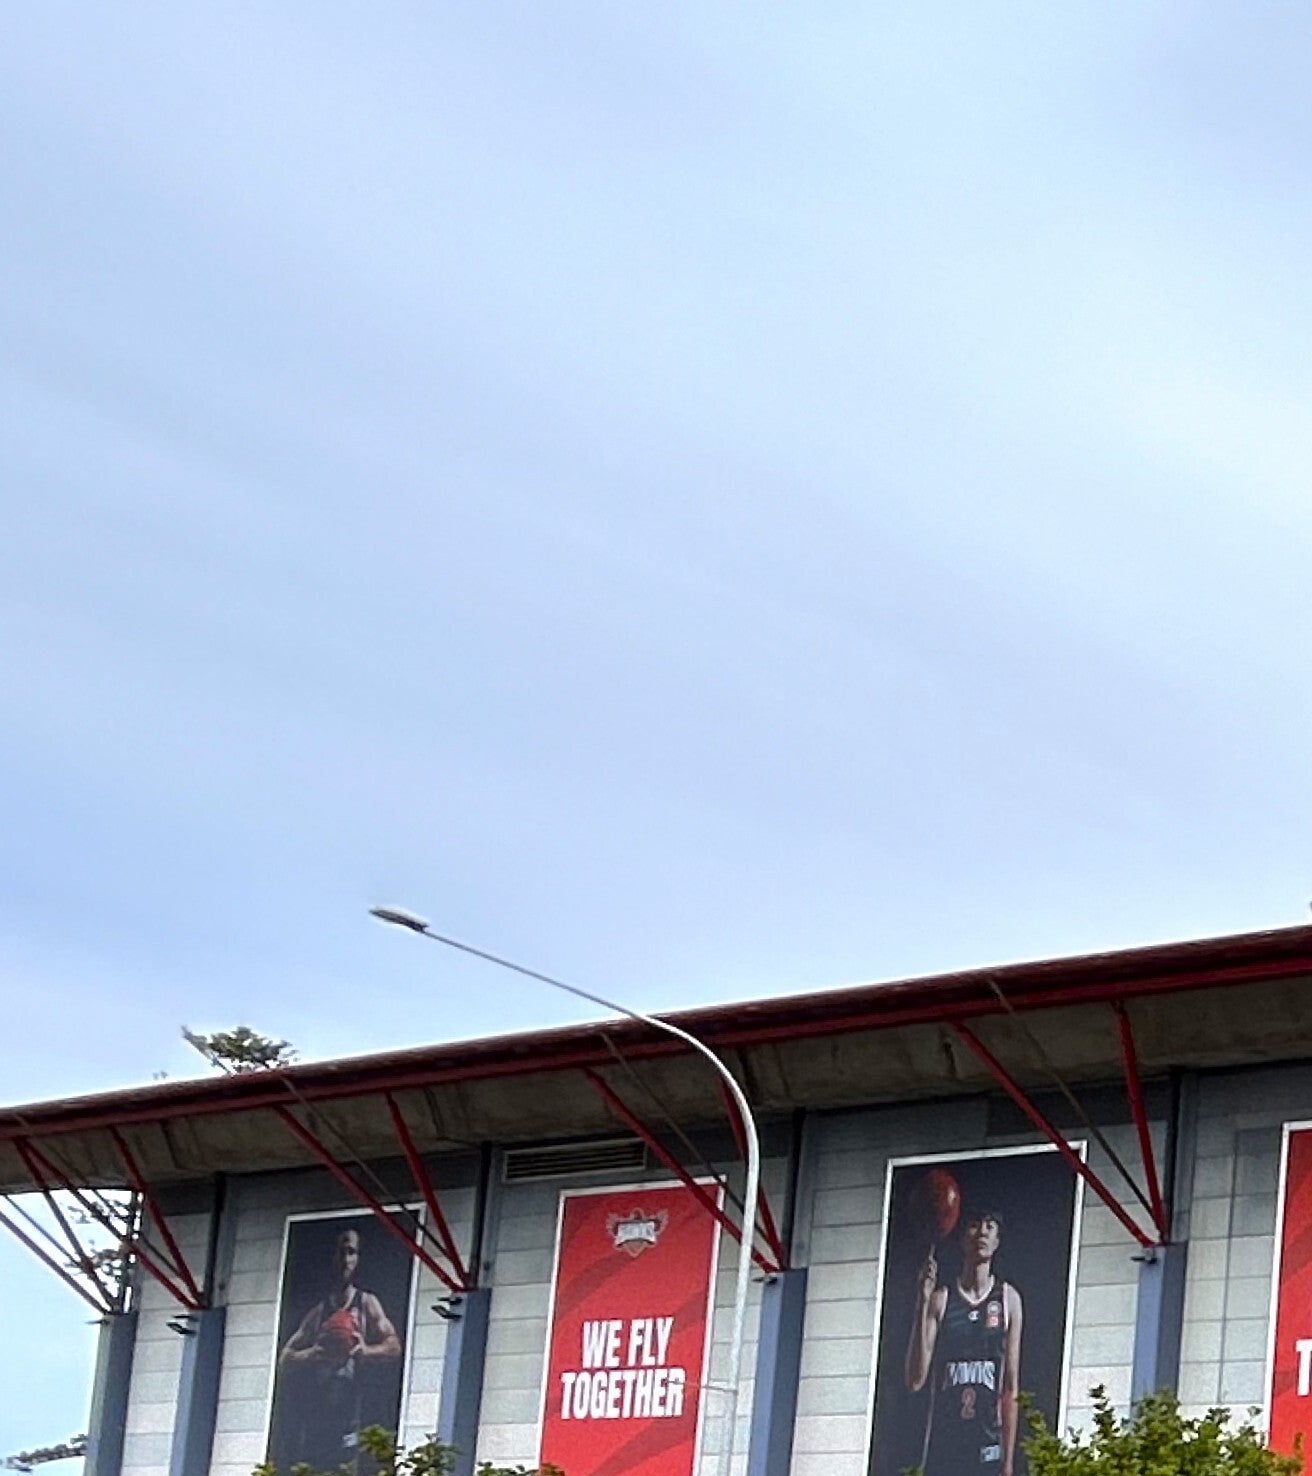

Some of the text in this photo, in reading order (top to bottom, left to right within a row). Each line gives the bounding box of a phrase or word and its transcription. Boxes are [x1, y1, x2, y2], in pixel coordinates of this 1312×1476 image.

[582, 1316, 674, 1369] WE FLY
[561, 1368, 686, 1420] TOGETHER
